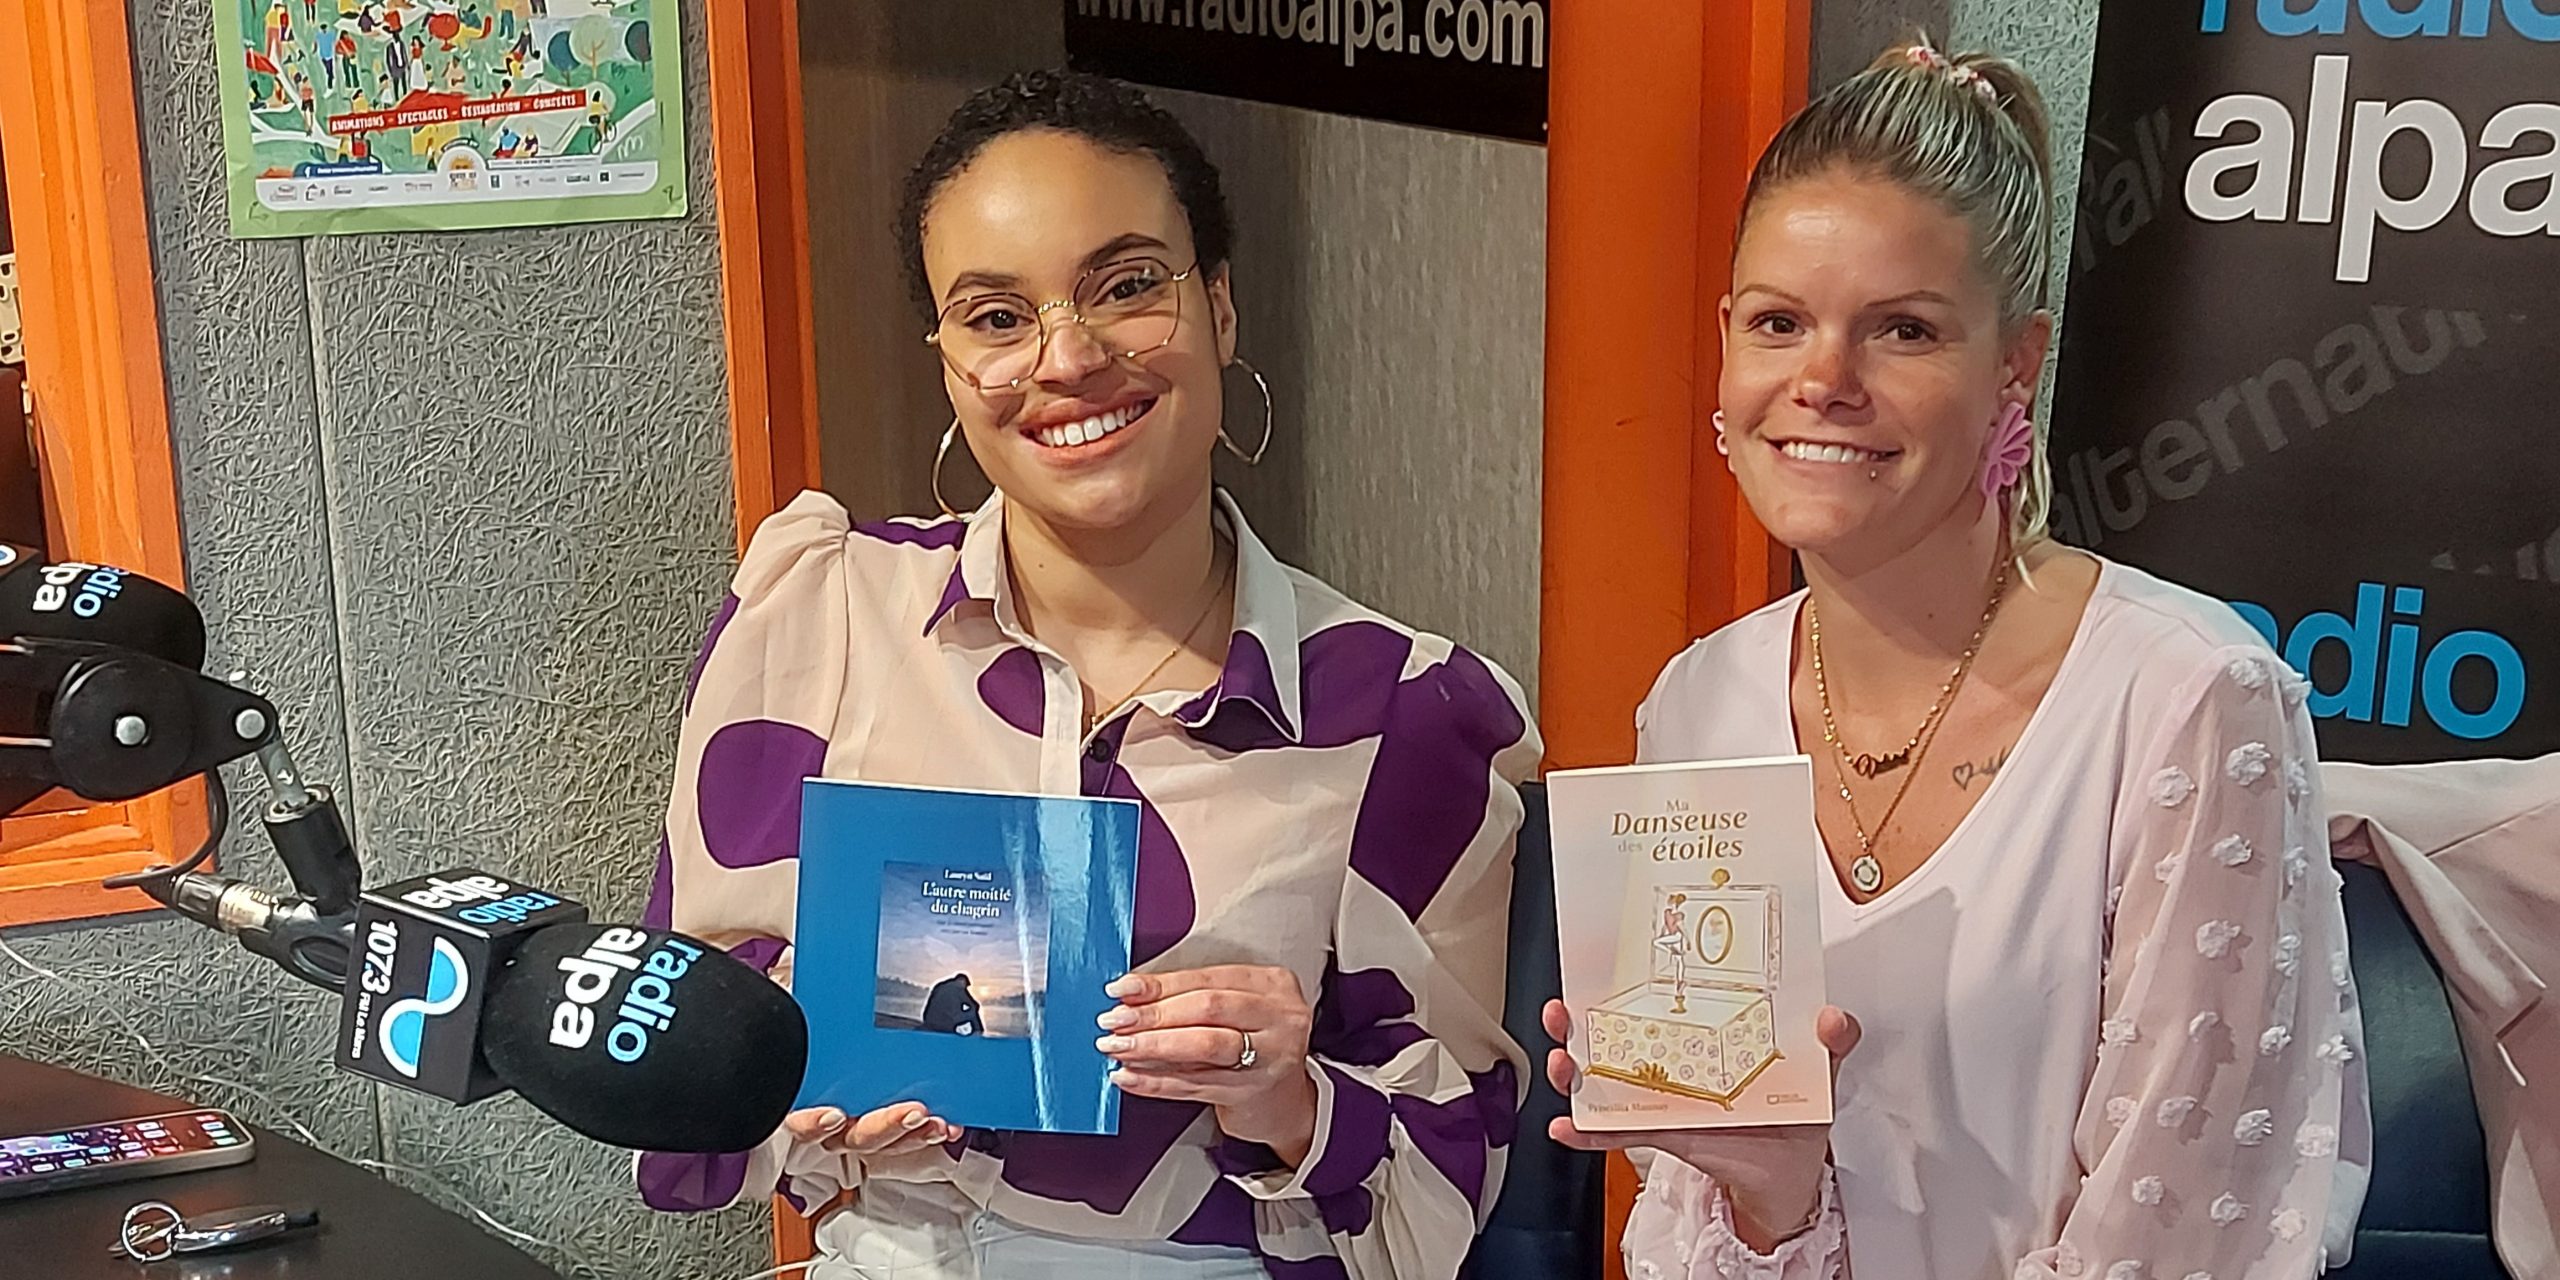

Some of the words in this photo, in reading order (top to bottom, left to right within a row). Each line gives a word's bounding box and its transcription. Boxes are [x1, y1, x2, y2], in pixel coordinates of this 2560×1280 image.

[2184, 53, 2560, 283] alpa
[32, 562, 98, 611] lpa
[73, 567, 130, 617] dio
[2229, 582, 2527, 739] dio
[1666, 800, 1689, 811] Ma
[1611, 811, 1748, 836] Danseuse
[1618, 840, 1642, 853] des
[1652, 835, 1743, 861] étoiles
[401, 876, 511, 909] alpa
[923, 882, 967, 898] L'autre
[458, 892, 561, 924] radio
[930, 898, 949, 914] du
[950, 900, 1000, 919] chagrin
[549, 927, 648, 1049] alpa
[607, 939, 704, 1063] radio
